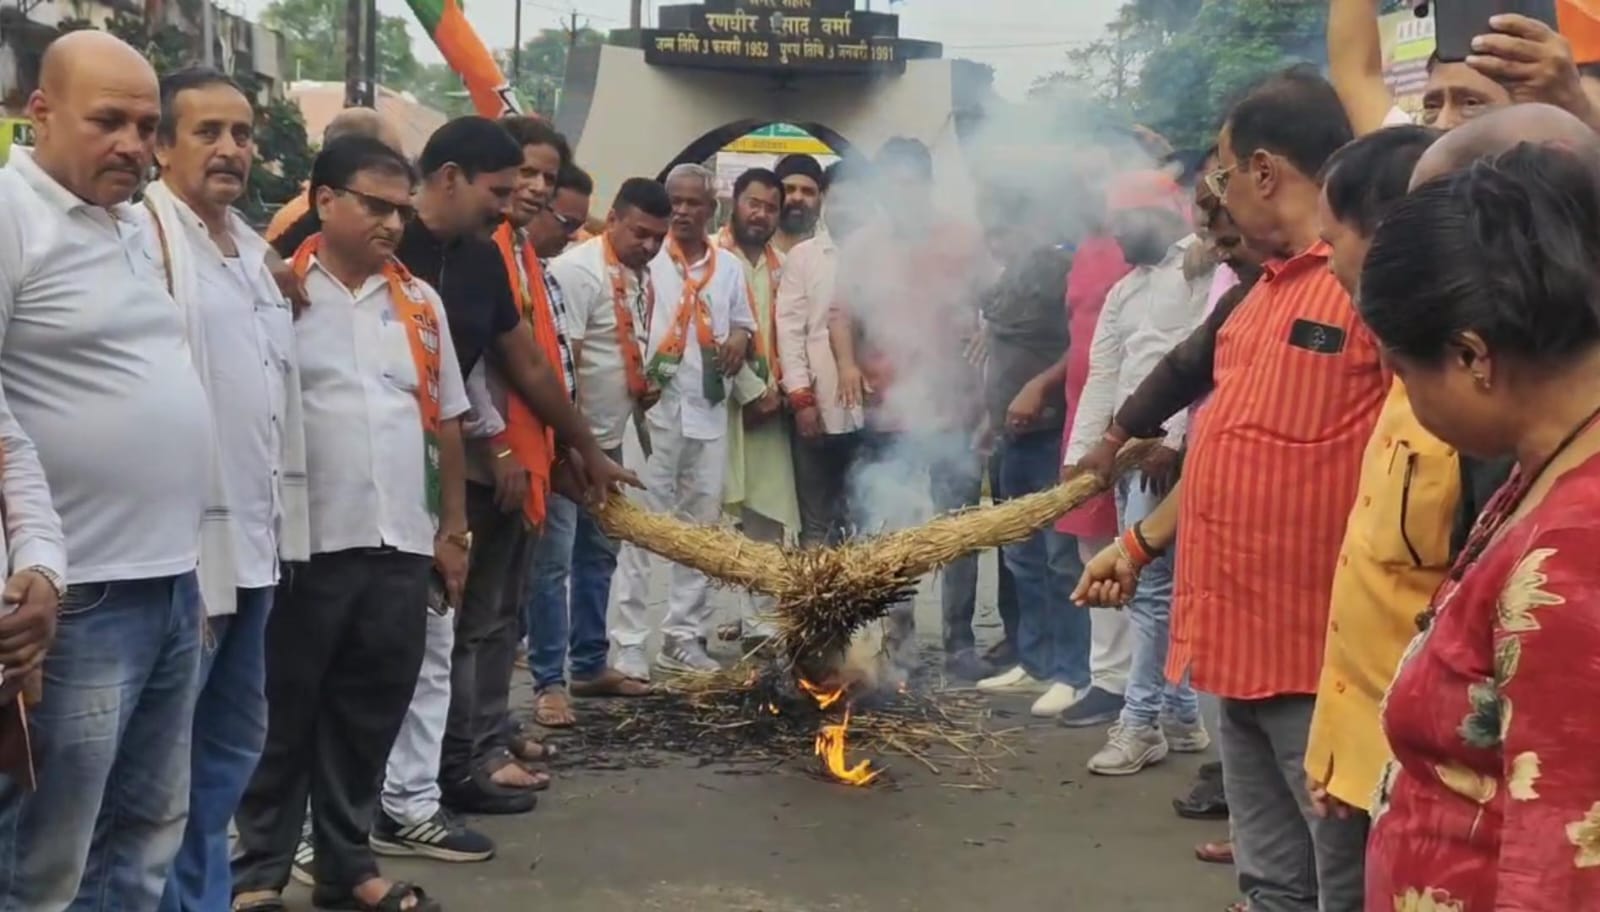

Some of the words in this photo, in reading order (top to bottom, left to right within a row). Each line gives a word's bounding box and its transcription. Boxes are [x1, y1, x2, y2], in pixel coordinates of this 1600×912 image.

[820, 10, 852, 36] वर्मा
[744, 40, 769, 57] 1952
[870, 45, 894, 61] 1991
